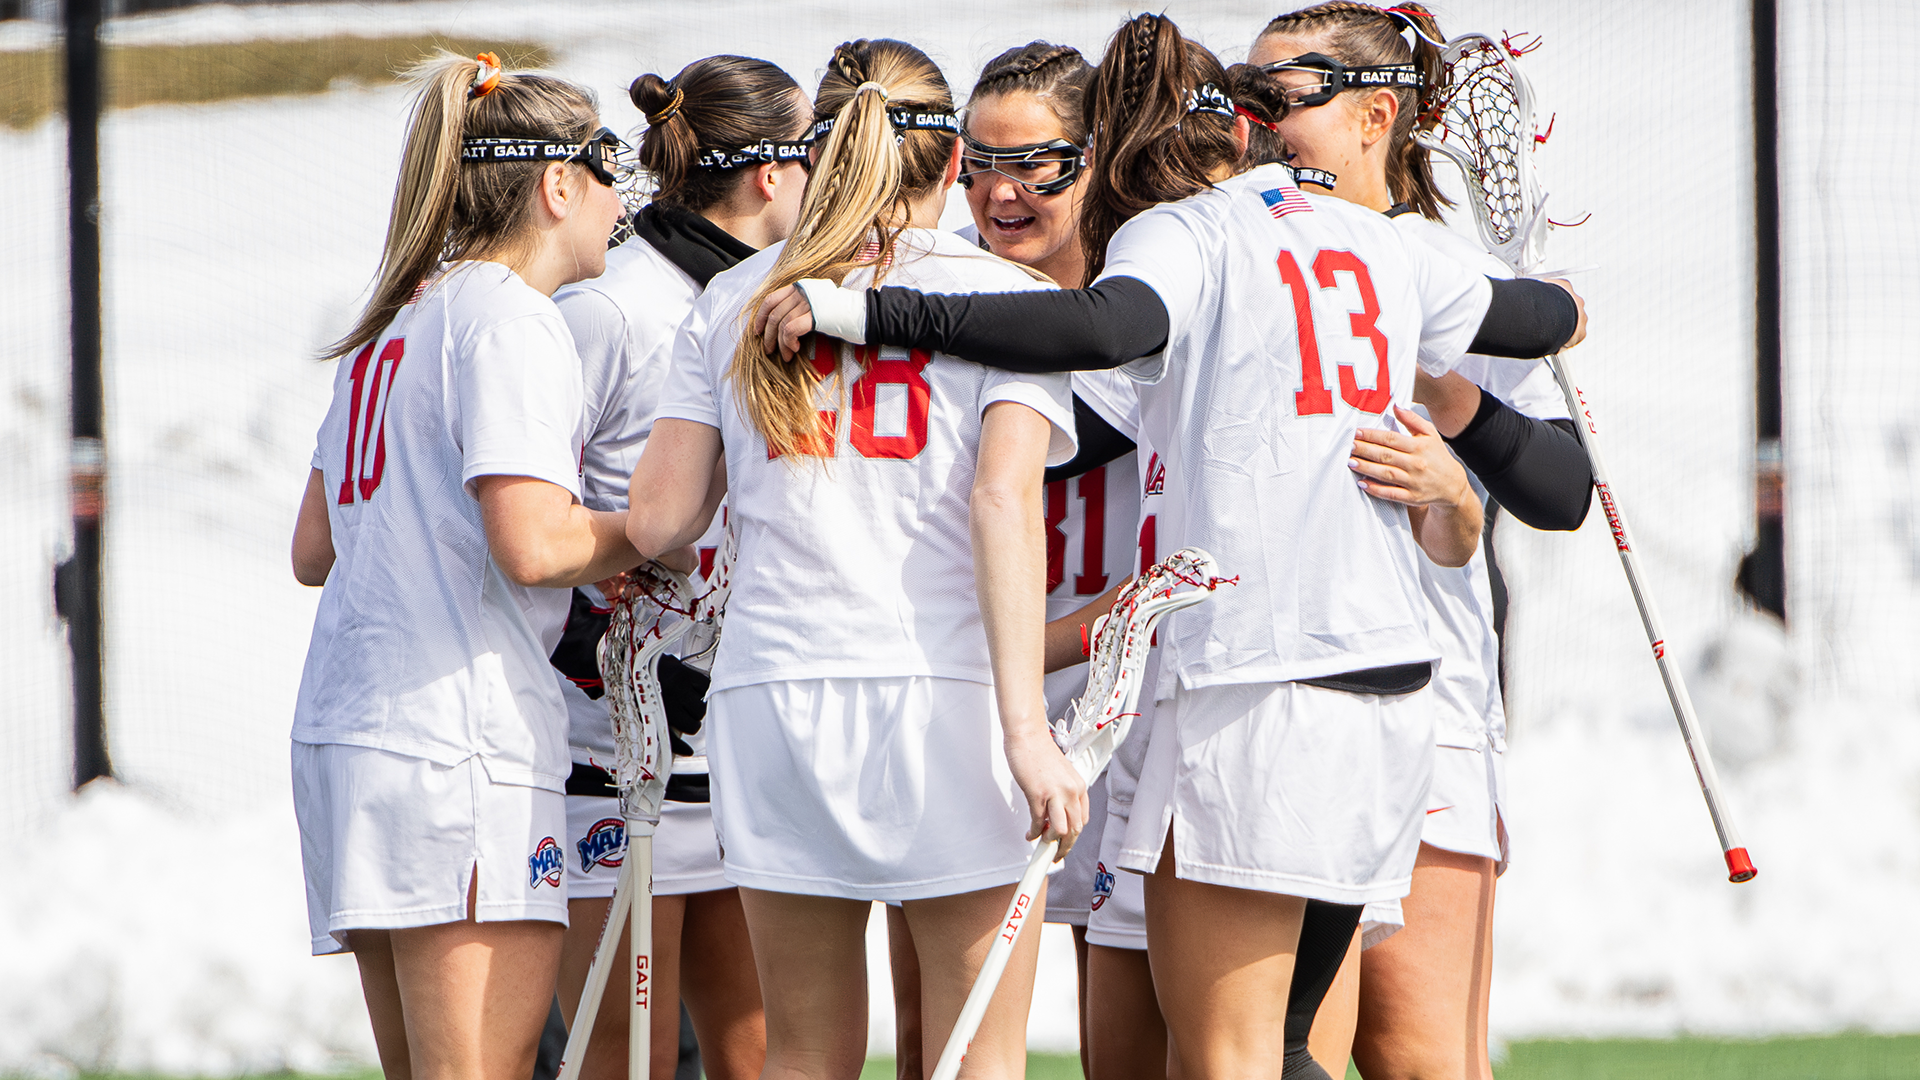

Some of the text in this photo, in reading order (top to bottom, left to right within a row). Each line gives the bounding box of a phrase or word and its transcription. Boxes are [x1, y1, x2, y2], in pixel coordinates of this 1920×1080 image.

[1361, 71, 1394, 83] GAIT
[915, 113, 945, 127] GAIT
[462, 146, 487, 158] AIT
[494, 144, 537, 157] GAIT
[544, 144, 581, 157] GAIT
[778, 144, 807, 158] GAI
[1274, 247, 1393, 418] 13
[338, 335, 406, 507] 10
[577, 827, 630, 873] MAA
[1002, 893, 1031, 945] GAIT
[636, 955, 649, 1010] GAIT
